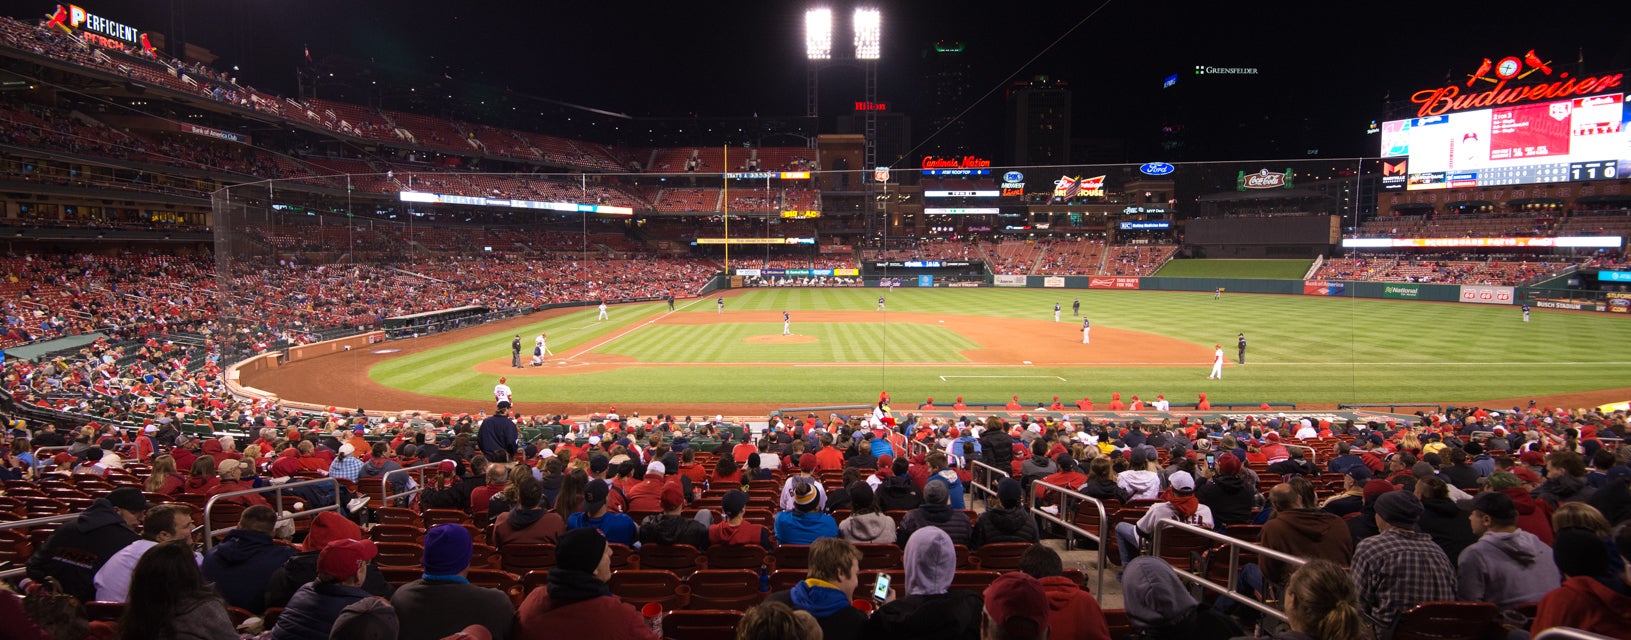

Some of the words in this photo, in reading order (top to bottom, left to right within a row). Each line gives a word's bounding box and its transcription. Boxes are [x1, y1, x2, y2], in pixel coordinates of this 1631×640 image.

[69, 4, 138, 43] PERFICIENT
[1411, 72, 1623, 117] Budweiser
[922, 156, 958, 170] Cardinals
[958, 156, 990, 169] Nation
[1147, 164, 1167, 172] Ford
[1572, 169, 1580, 180] 1
[1588, 168, 1596, 178] 1
[1604, 166, 1616, 178] 0
[1054, 180, 1103, 188] Buweiser
